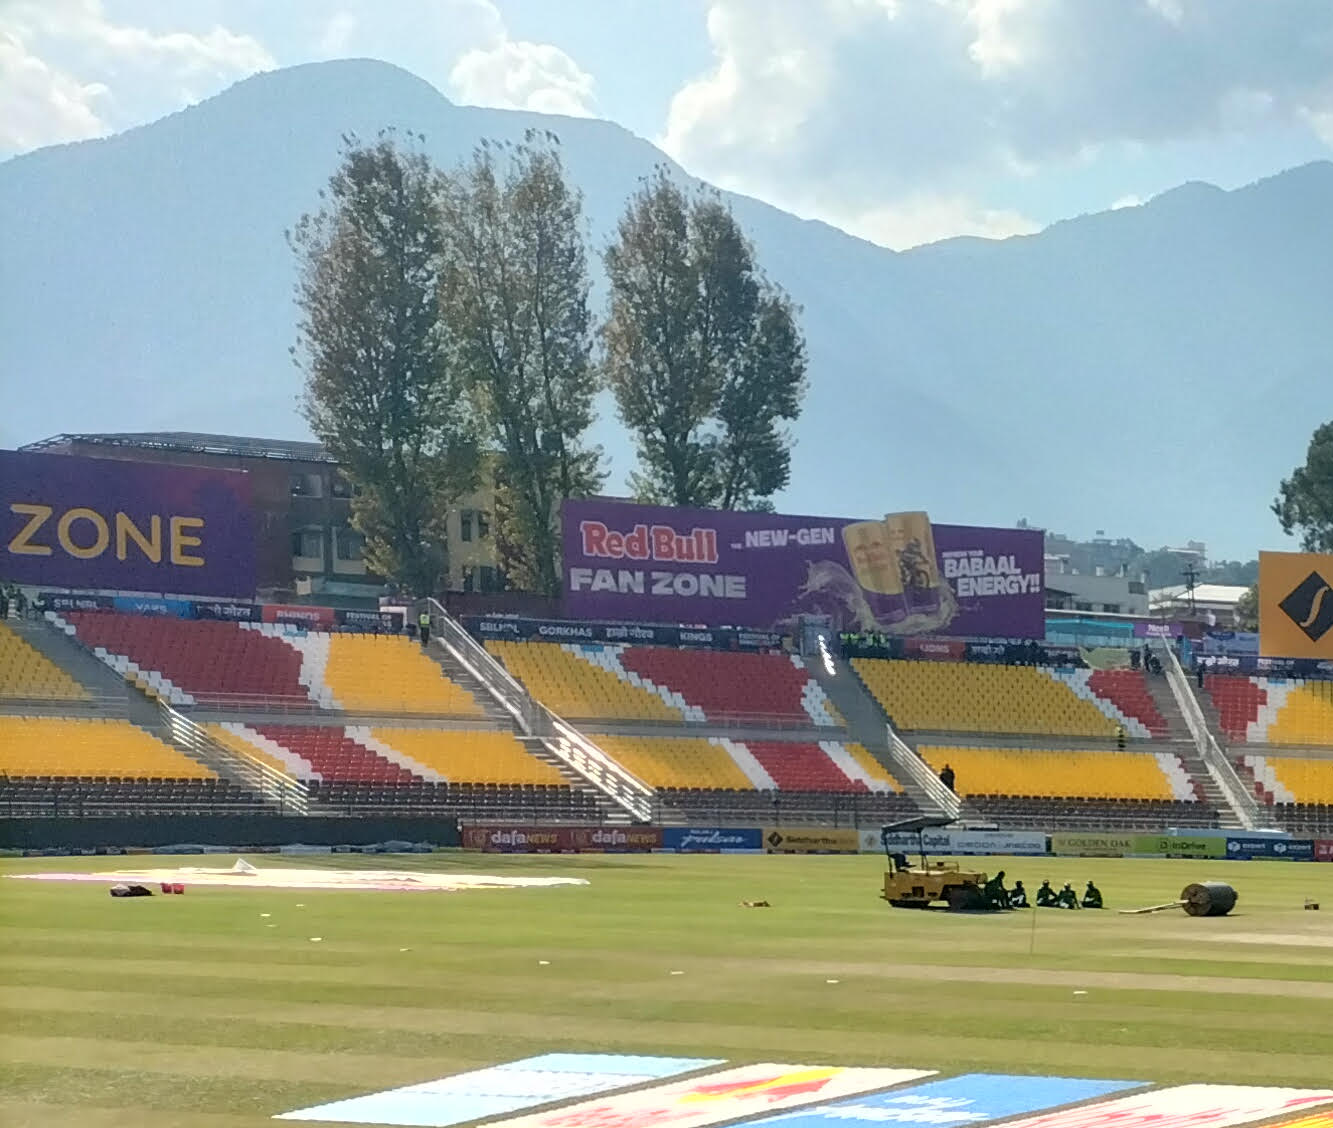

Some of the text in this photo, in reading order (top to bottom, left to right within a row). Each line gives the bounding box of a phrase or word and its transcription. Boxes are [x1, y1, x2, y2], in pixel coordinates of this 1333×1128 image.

[7, 503, 206, 567] ZONE
[580, 520, 719, 565] Red Bull
[744, 527, 835, 549] NEW-GEN
[944, 555, 1021, 579] BABAAL
[569, 567, 747, 598] FAN ZONE
[957, 573, 1041, 598] ENERGY!!
[538, 625, 593, 638] GORKHAS
[1110, 839, 1132, 848] OAK
